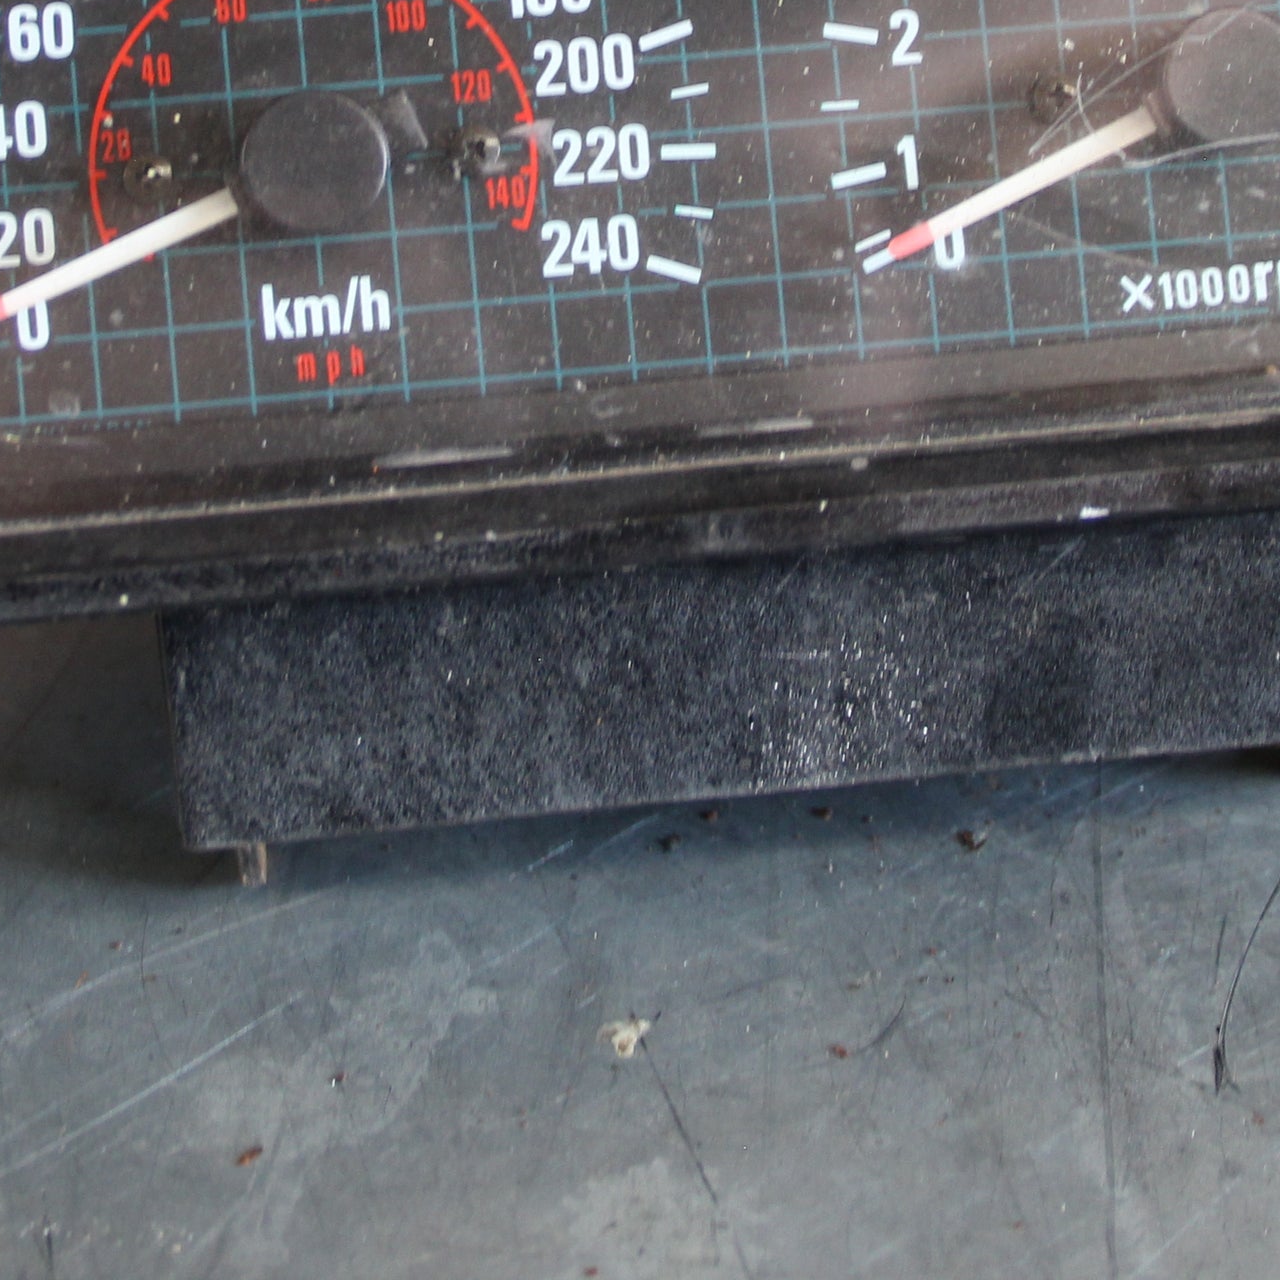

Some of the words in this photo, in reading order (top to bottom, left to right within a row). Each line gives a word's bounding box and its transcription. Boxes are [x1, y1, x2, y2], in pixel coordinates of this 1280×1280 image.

[8, 2, 74, 62] 60
[386, 0, 426, 32] 100
[890, 11, 923, 66] 2
[142, 53, 171, 86] 40
[450, 70, 491, 103] 120
[534, 34, 634, 97] 200
[553, 124, 650, 186] 220
[897, 136, 918, 189] 1
[486, 175, 527, 209] 140
[541, 214, 639, 278] 240
[17, 300, 50, 351] 0
[262, 277, 391, 340] km/h
